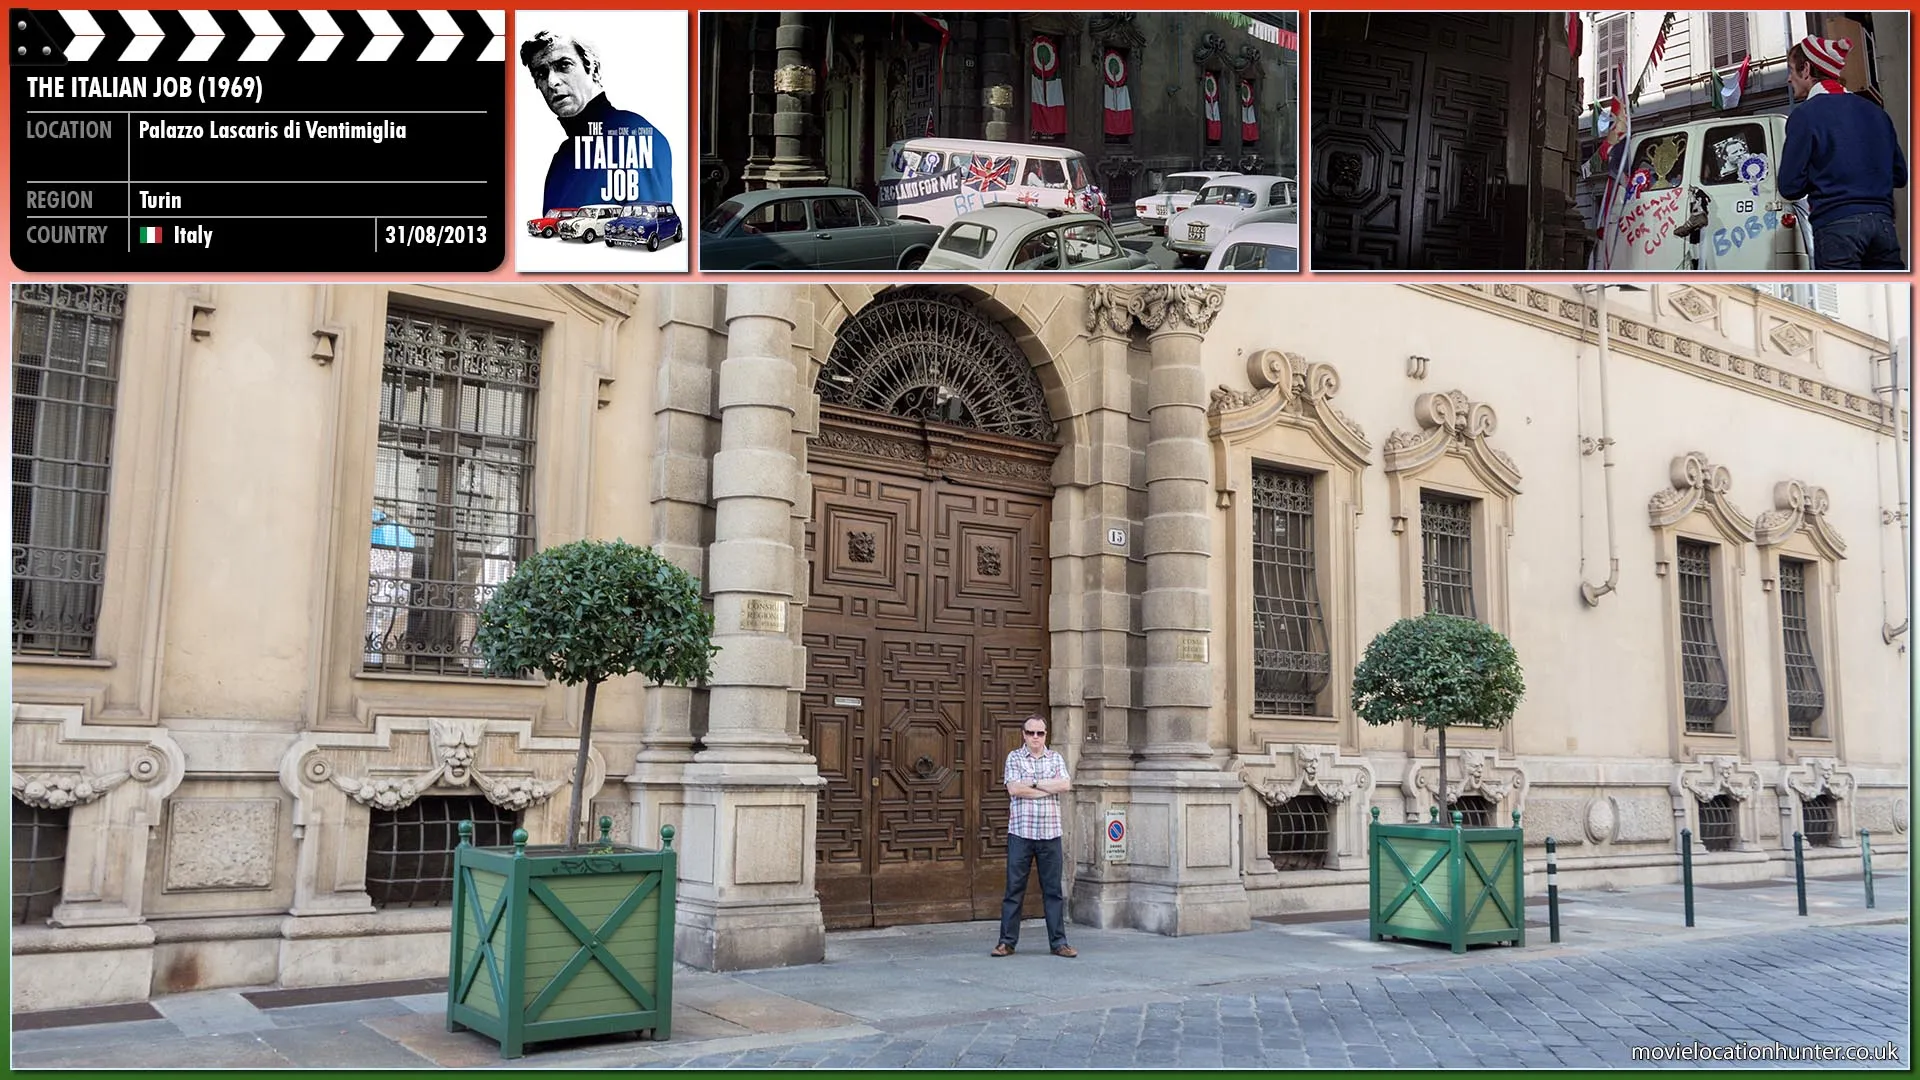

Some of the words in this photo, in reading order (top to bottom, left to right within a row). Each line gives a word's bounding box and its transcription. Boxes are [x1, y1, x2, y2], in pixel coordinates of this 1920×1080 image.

[587, 121, 604, 136] THE
[574, 135, 653, 170] ITALIAN
[600, 169, 639, 202] JOB
[919, 178, 940, 197] FOR
[940, 172, 959, 192] ME
[1618, 187, 1683, 233] ENGLAND
[1736, 200, 1754, 213] GB
[1626, 222, 1650, 246] FOR
[1653, 200, 1679, 221] THE
[1112, 531, 1123, 543] 15
